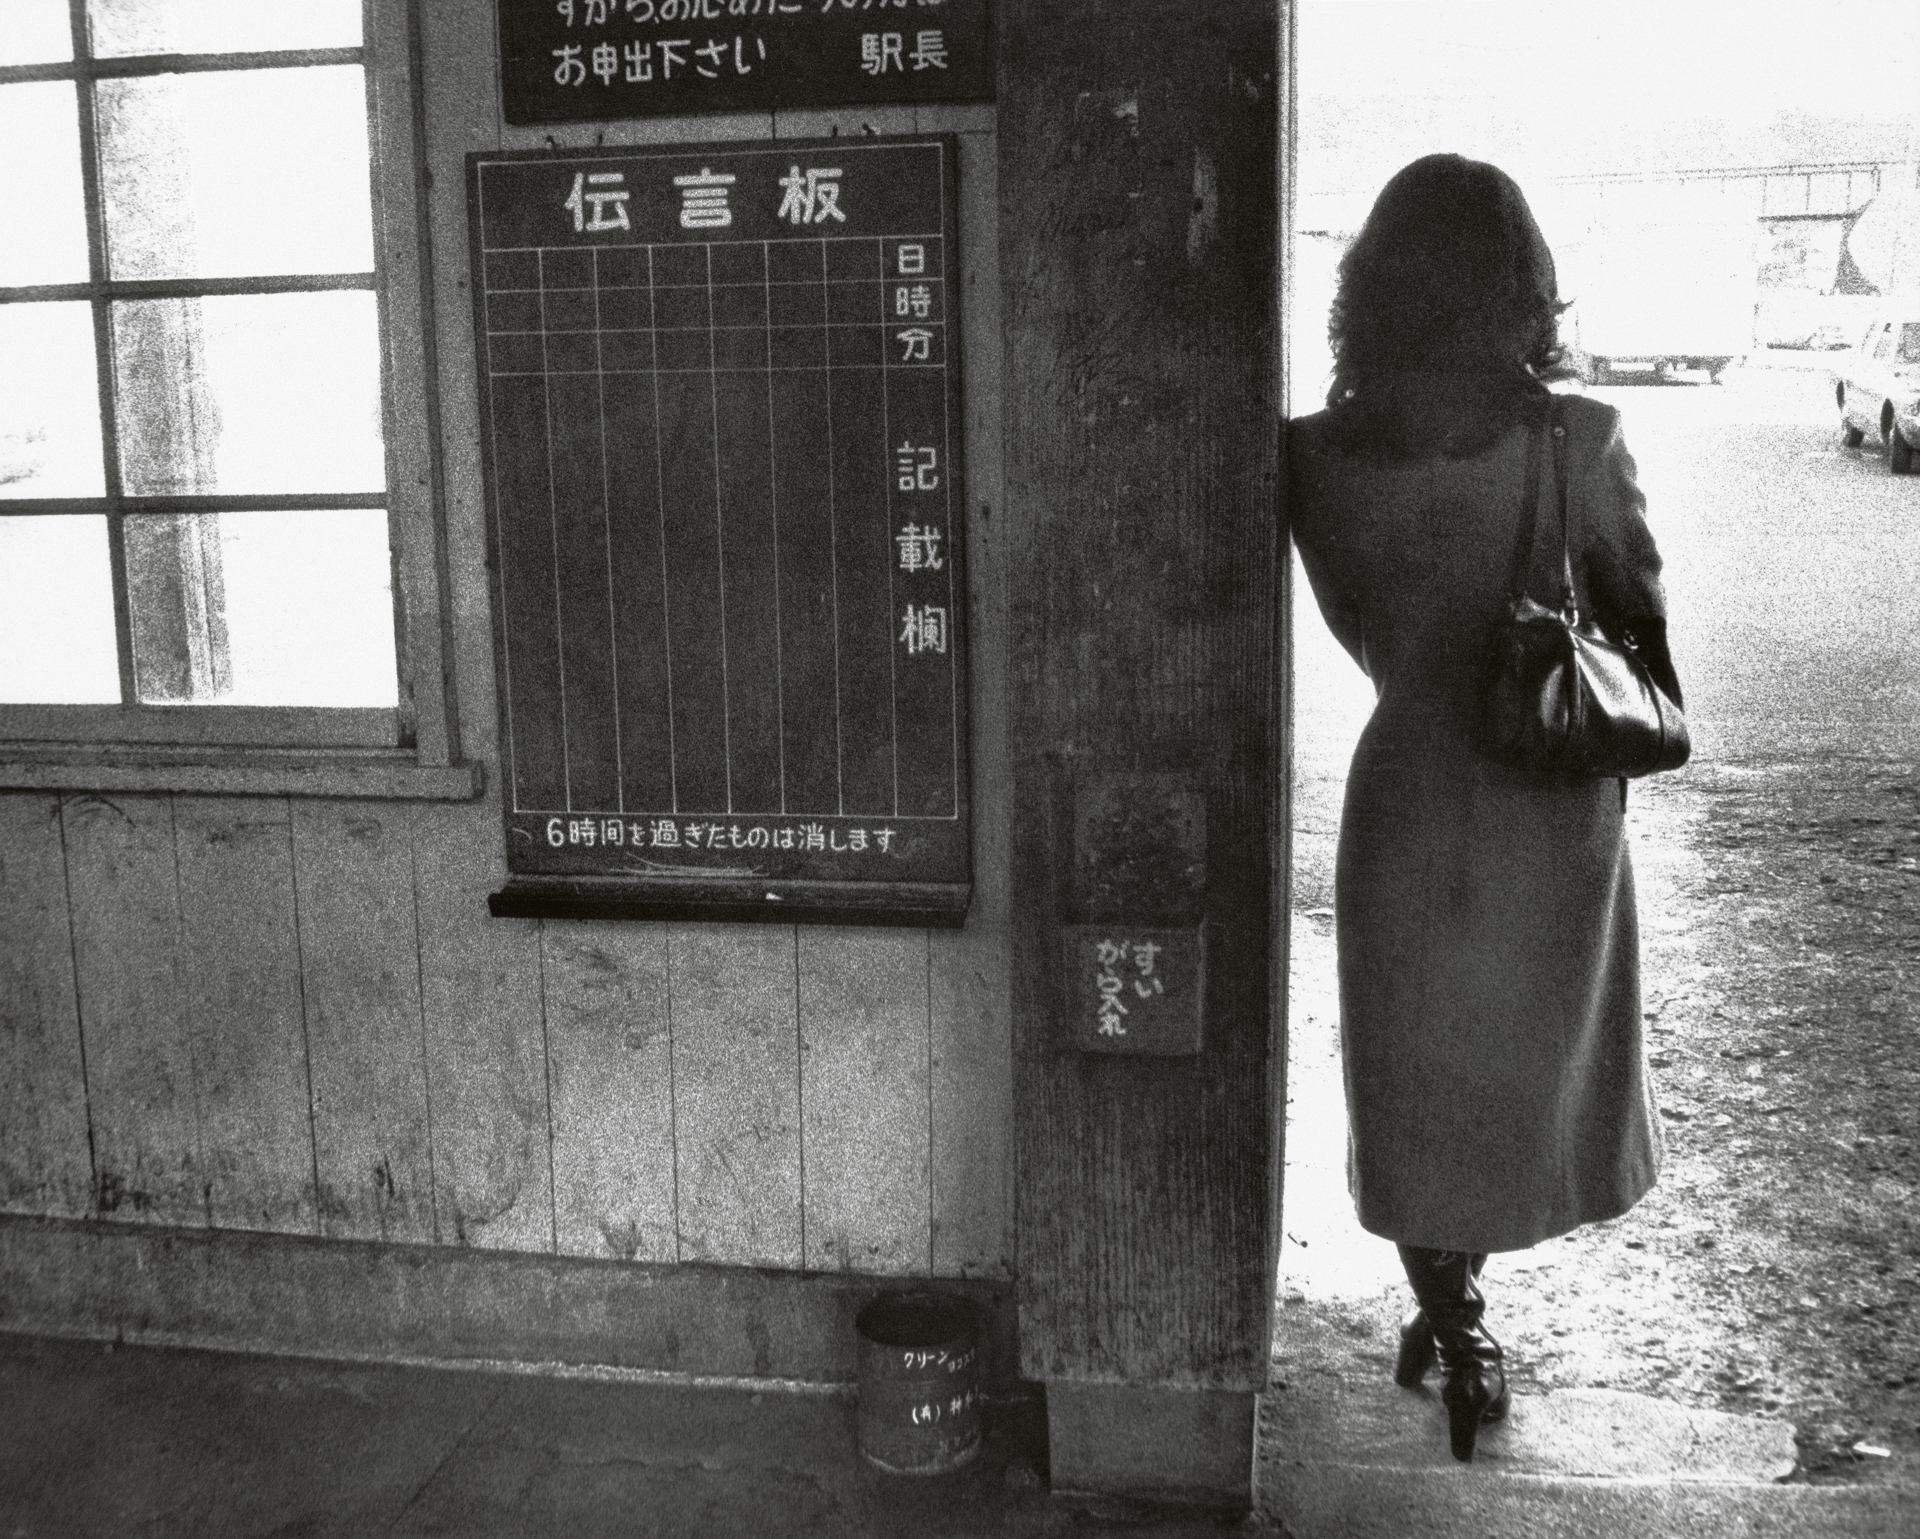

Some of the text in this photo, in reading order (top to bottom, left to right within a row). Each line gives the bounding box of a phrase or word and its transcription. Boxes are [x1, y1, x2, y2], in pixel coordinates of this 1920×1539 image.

[552, 31, 947, 86] お申出下さい 駅長
[564, 165, 847, 232] 伝言板
[895, 441, 947, 654] 記載欄
[547, 816, 898, 853] 6時間を過ぎたものは消します
